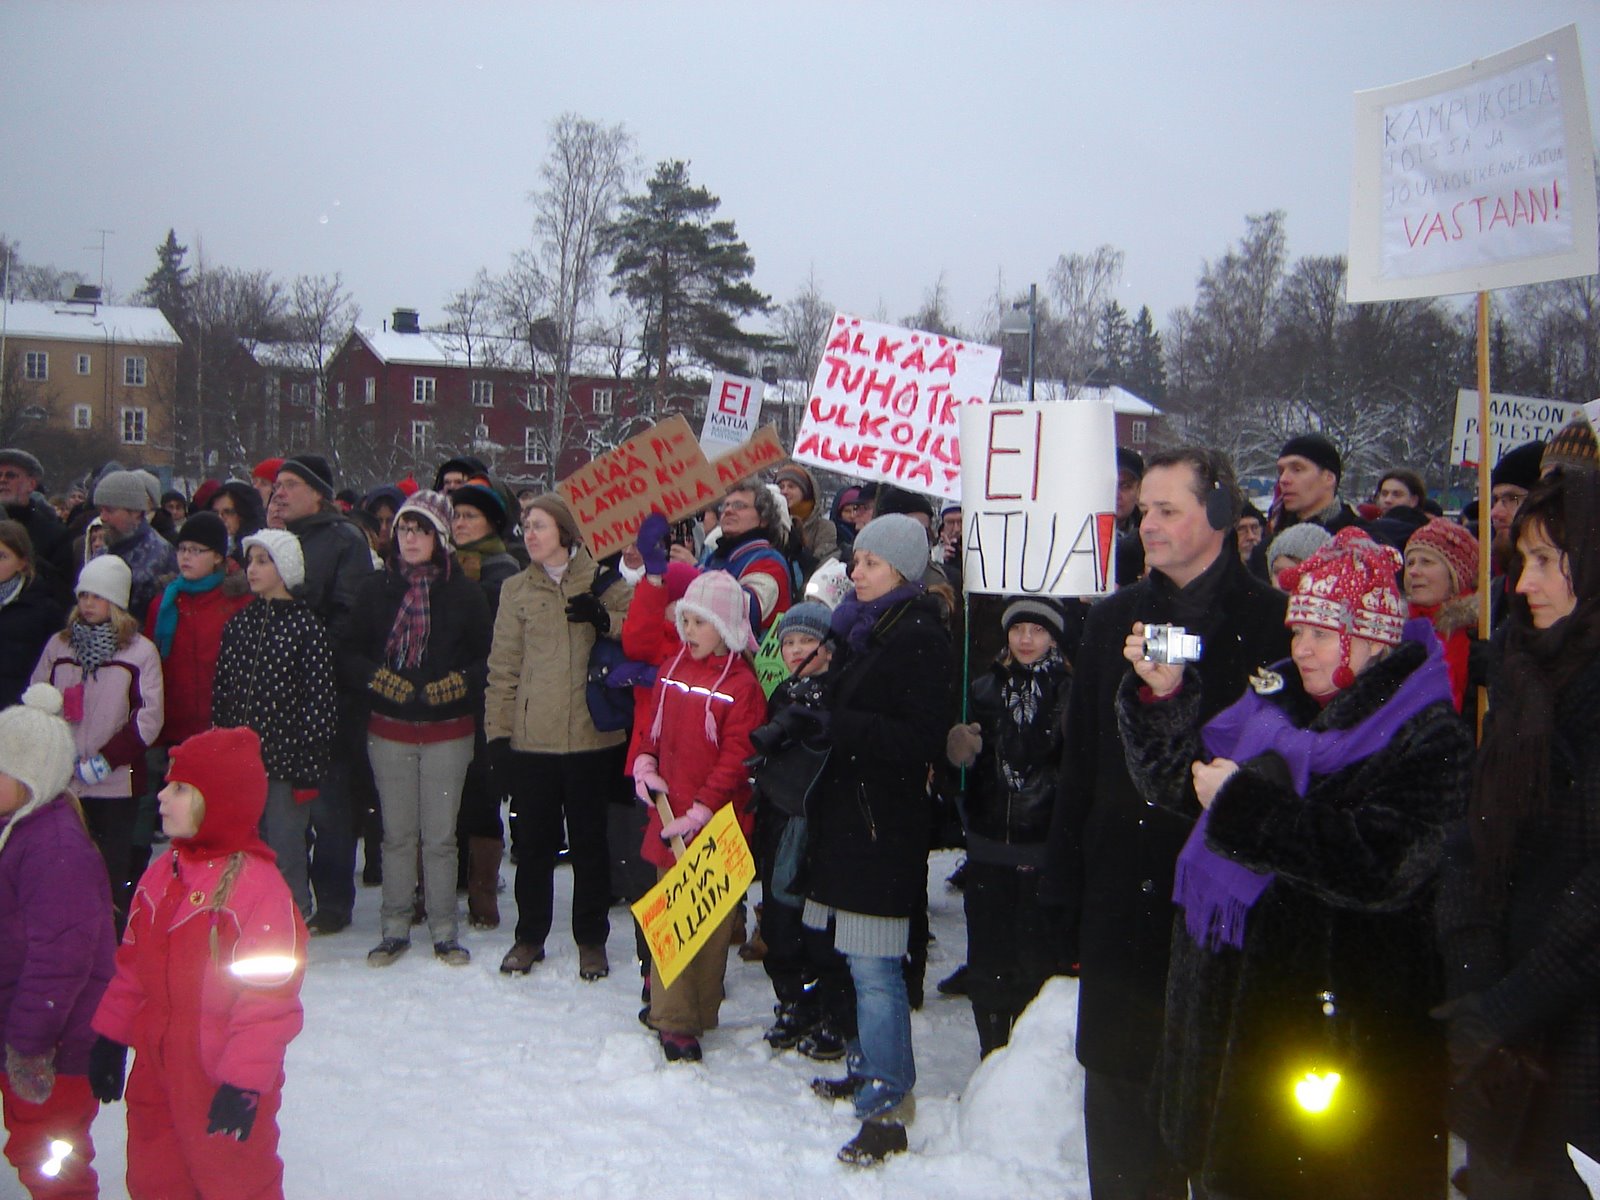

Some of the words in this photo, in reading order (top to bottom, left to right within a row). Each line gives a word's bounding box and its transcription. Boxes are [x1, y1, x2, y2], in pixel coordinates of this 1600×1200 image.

[1385, 73, 1556, 148] KAMPUKSELLA
[1485, 128, 1504, 150] JA
[1403, 179, 1559, 248] VASTAAN!
[826, 316, 964, 376] ÄLKÄÄ
[718, 380, 752, 417] EI
[825, 356, 983, 425] TUHOTK
[1489, 400, 1564, 424] AAKSON
[711, 412, 748, 431] KATUA
[565, 442, 648, 505] ÄLKÄÄ
[985, 410, 1042, 501] EI
[579, 476, 648, 524] LATKO
[666, 836, 717, 909] KATU?
[690, 868, 714, 904] VAI
[673, 874, 730, 951] NIITTY
